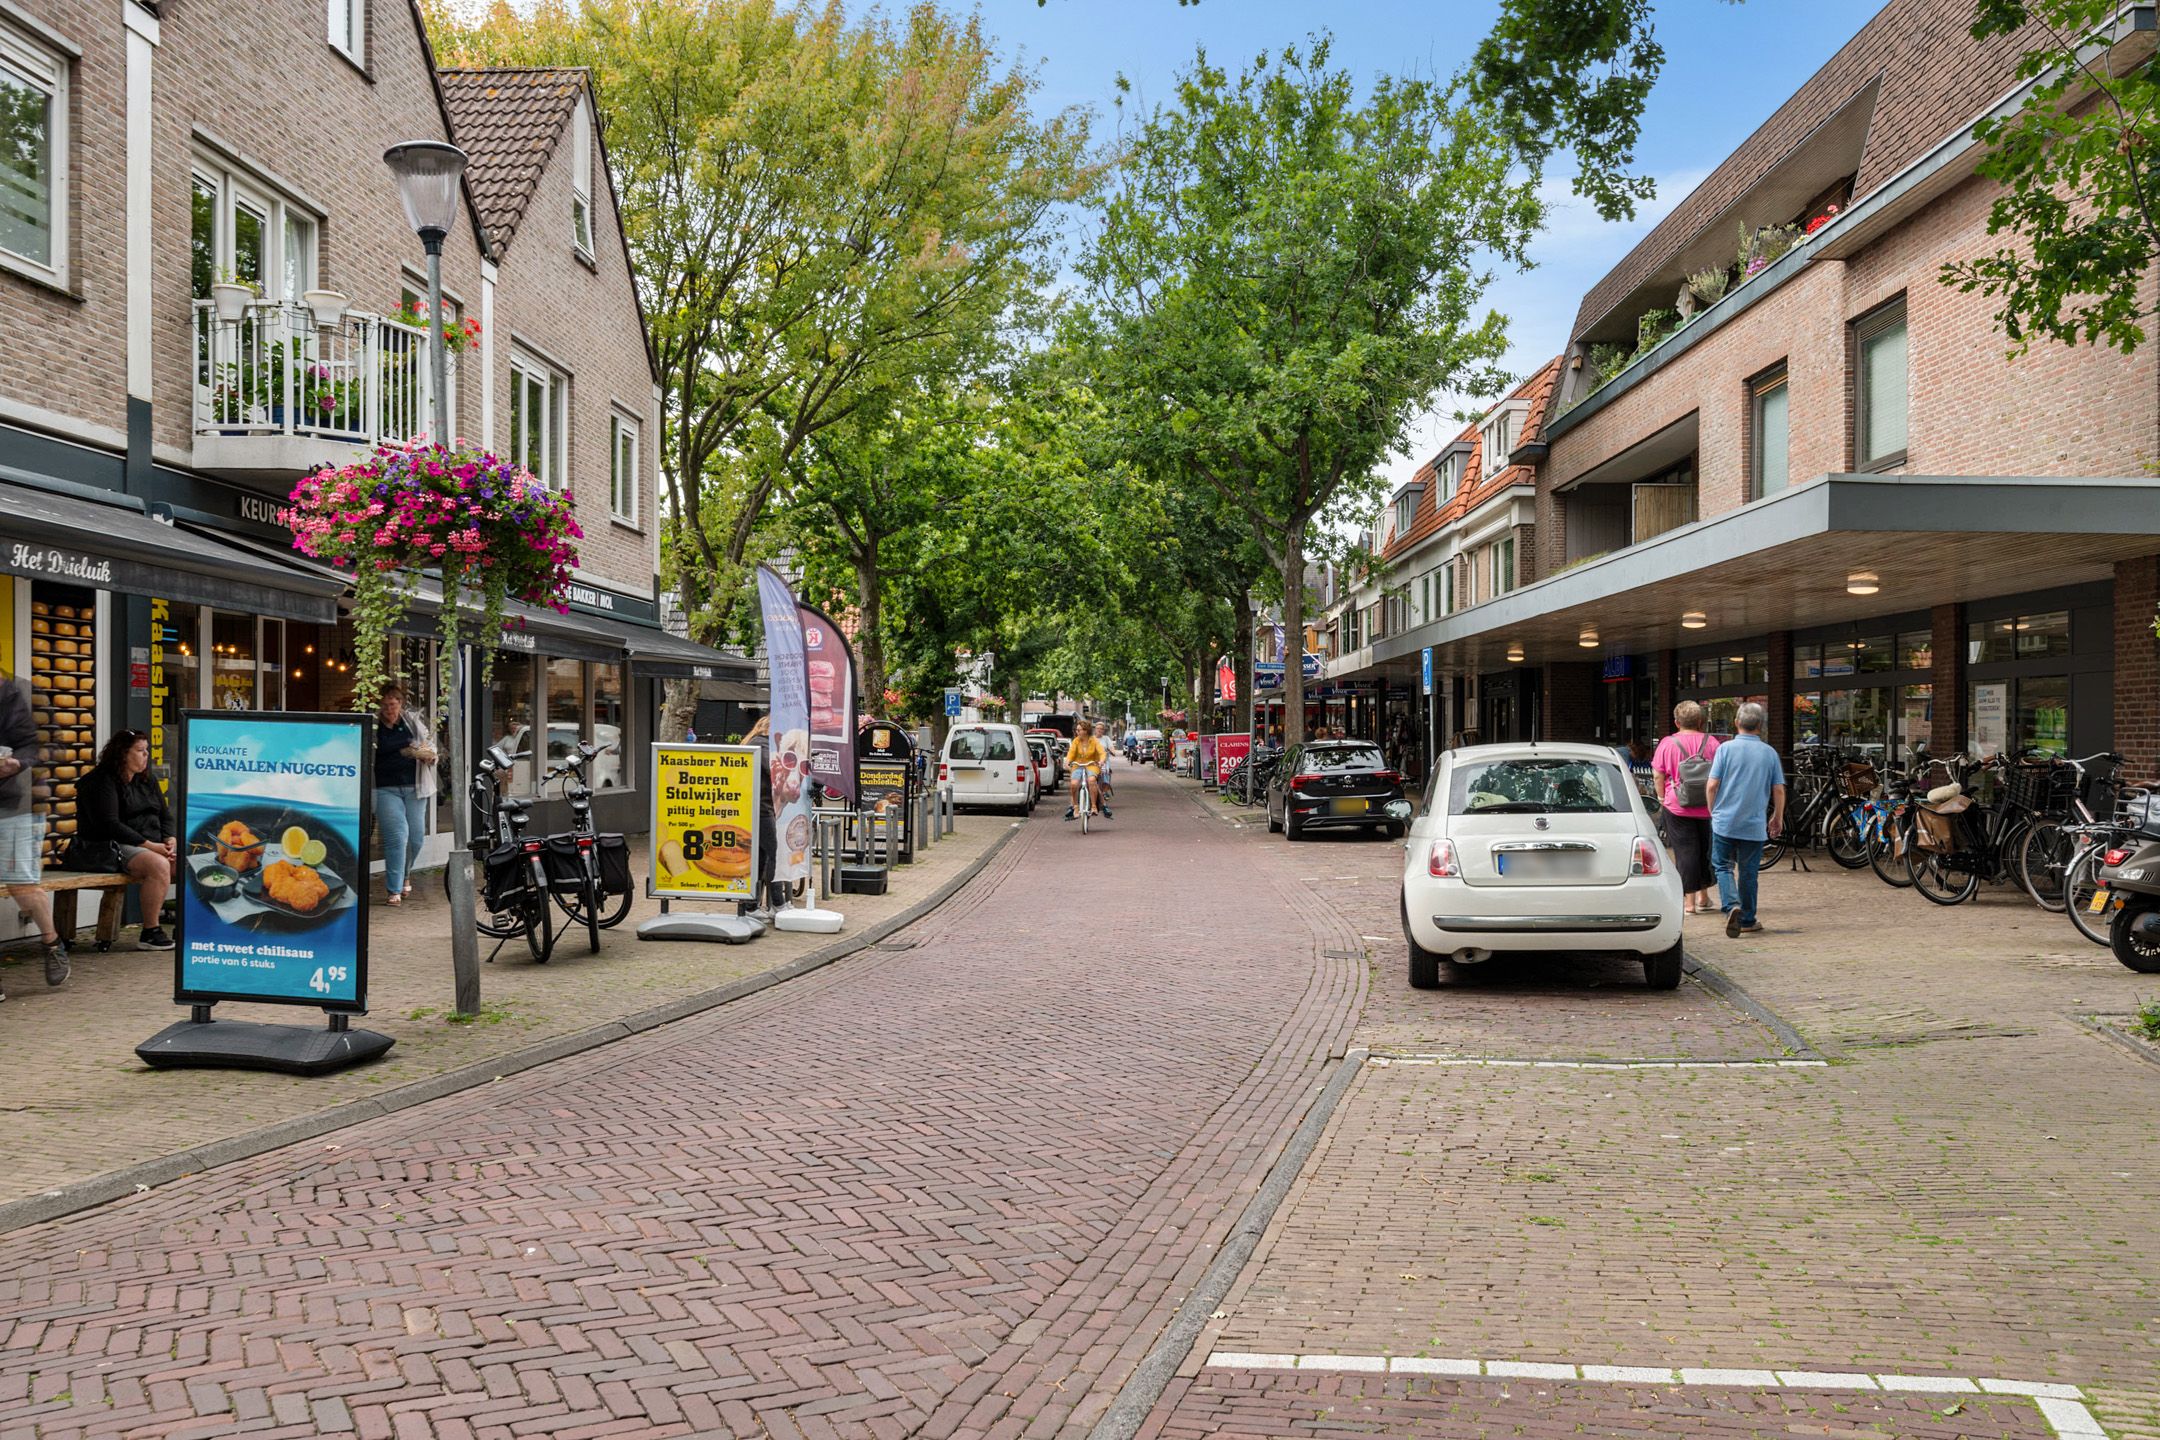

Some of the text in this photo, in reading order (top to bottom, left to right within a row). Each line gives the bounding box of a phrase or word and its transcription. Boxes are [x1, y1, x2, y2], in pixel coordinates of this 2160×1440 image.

[10, 544, 111, 582] Het Drieluik
[573, 586, 597, 606] BAKKER
[599, 594, 613, 610] MOL
[1424, 652, 1429, 672] P
[151, 598, 169, 767] Kaasboer
[949, 695, 957, 705] P
[195, 745, 248, 756] KROKANTE
[194, 757, 357, 777] GARNALEN NUGGETS
[660, 755, 748, 767] Kaasboer Niek
[678, 771, 729, 785] Boeren
[860, 772, 903, 780] Donderdag
[666, 786, 741, 804] Stolwijker
[667, 805, 740, 818] pittig belegen
[683, 830, 736, 860] 8,99
[191, 941, 314, 959] met sweet chilisaus
[191, 954, 276, 969] portie van 6 stuks
[308, 965, 348, 994] 4,95
